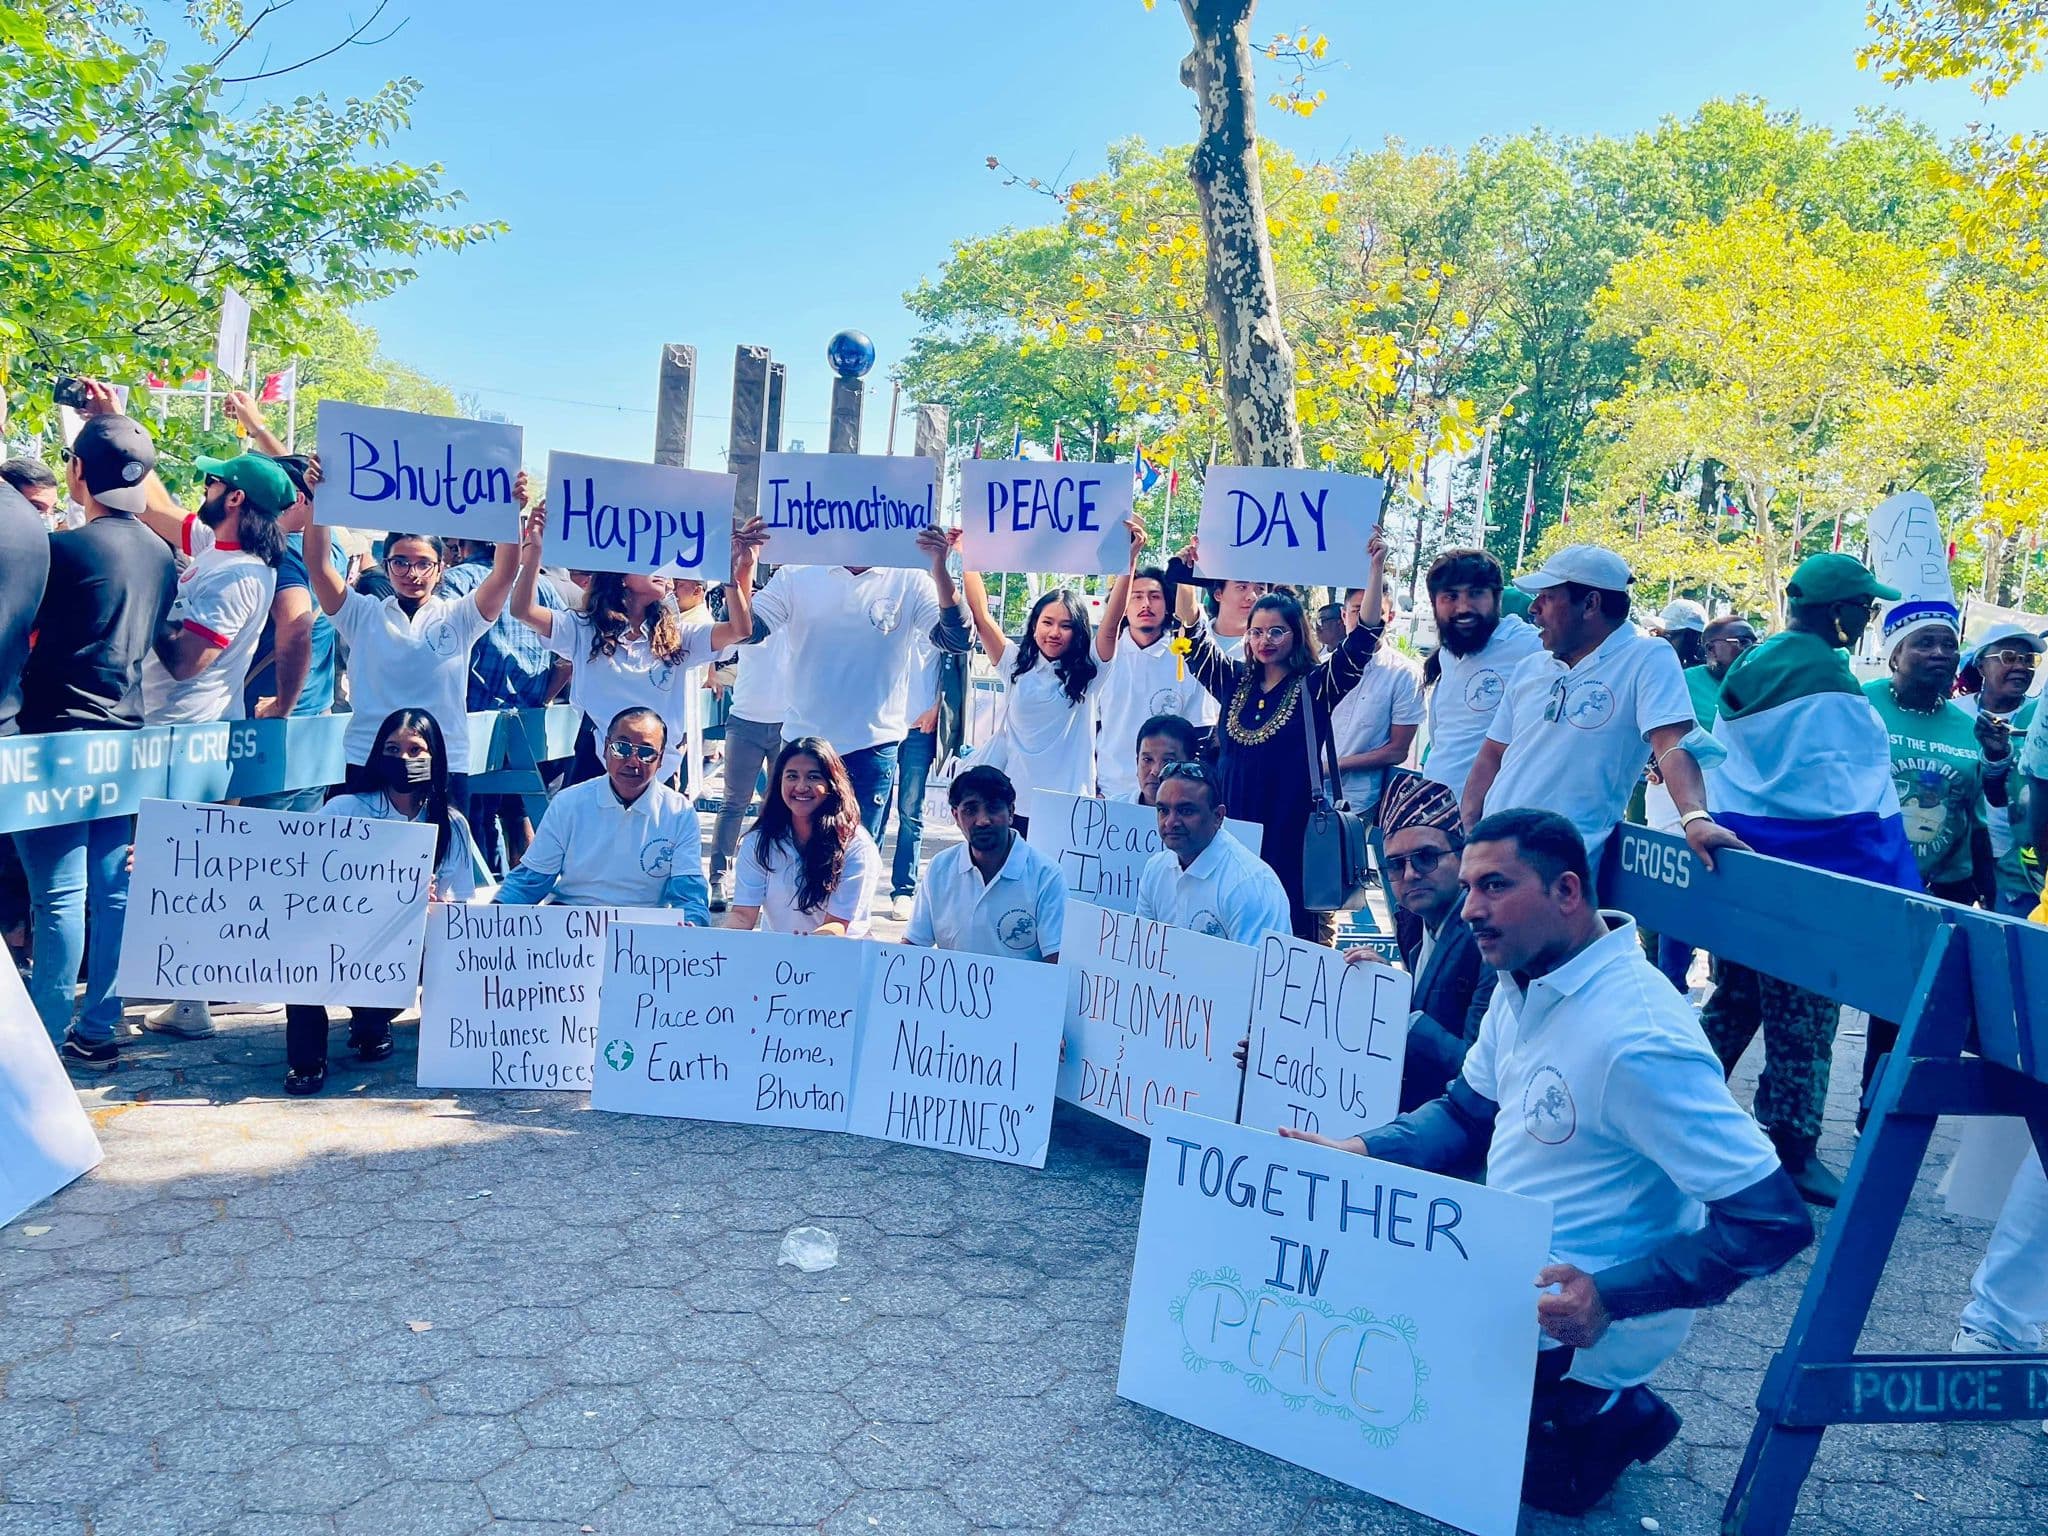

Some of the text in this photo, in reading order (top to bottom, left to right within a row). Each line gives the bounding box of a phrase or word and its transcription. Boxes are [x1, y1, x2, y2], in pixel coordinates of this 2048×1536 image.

[343, 431, 512, 515] Bhutan
[561, 477, 706, 569] Happy
[767, 479, 934, 535] International
[987, 477, 1101, 533] PEACE
[1227, 489, 1329, 552] DAY
[87, 740, 120, 774] DO
[132, 734, 182, 770] NOT
[188, 728, 257, 764] CROSS
[1906, 737, 1927, 752] THE
[1930, 742, 1979, 760] PROCESS
[27, 782, 119, 815] NYPD
[279, 817, 371, 841] world's
[322, 849, 429, 904] Country"
[1621, 835, 1691, 889] CROSS
[151, 888, 373, 920] needs a peace
[219, 918, 270, 940] and
[528, 944, 596, 970] include
[614, 929, 727, 993] Happiest
[775, 960, 816, 986] Our
[485, 975, 585, 1012] Happiness
[880, 950, 993, 1019] "GROSS
[1259, 936, 1395, 1061] PEACE
[450, 1018, 550, 1049] Bhutanese
[635, 993, 734, 1030] Place on
[766, 994, 853, 1029] Former
[647, 1042, 728, 1082] Earth
[761, 1035, 834, 1067] Home,
[893, 1019, 1017, 1091] National
[1257, 1027, 1327, 1099] Leads
[756, 1073, 844, 1113] Bhutan
[885, 1091, 1034, 1157] HAPPINESS"
[1167, 1136, 1469, 1261] TOGETHER
[1264, 1235, 1329, 1297] IN
[1200, 1282, 1397, 1413] PEACE
[1854, 1368, 2002, 1414] POLICE
